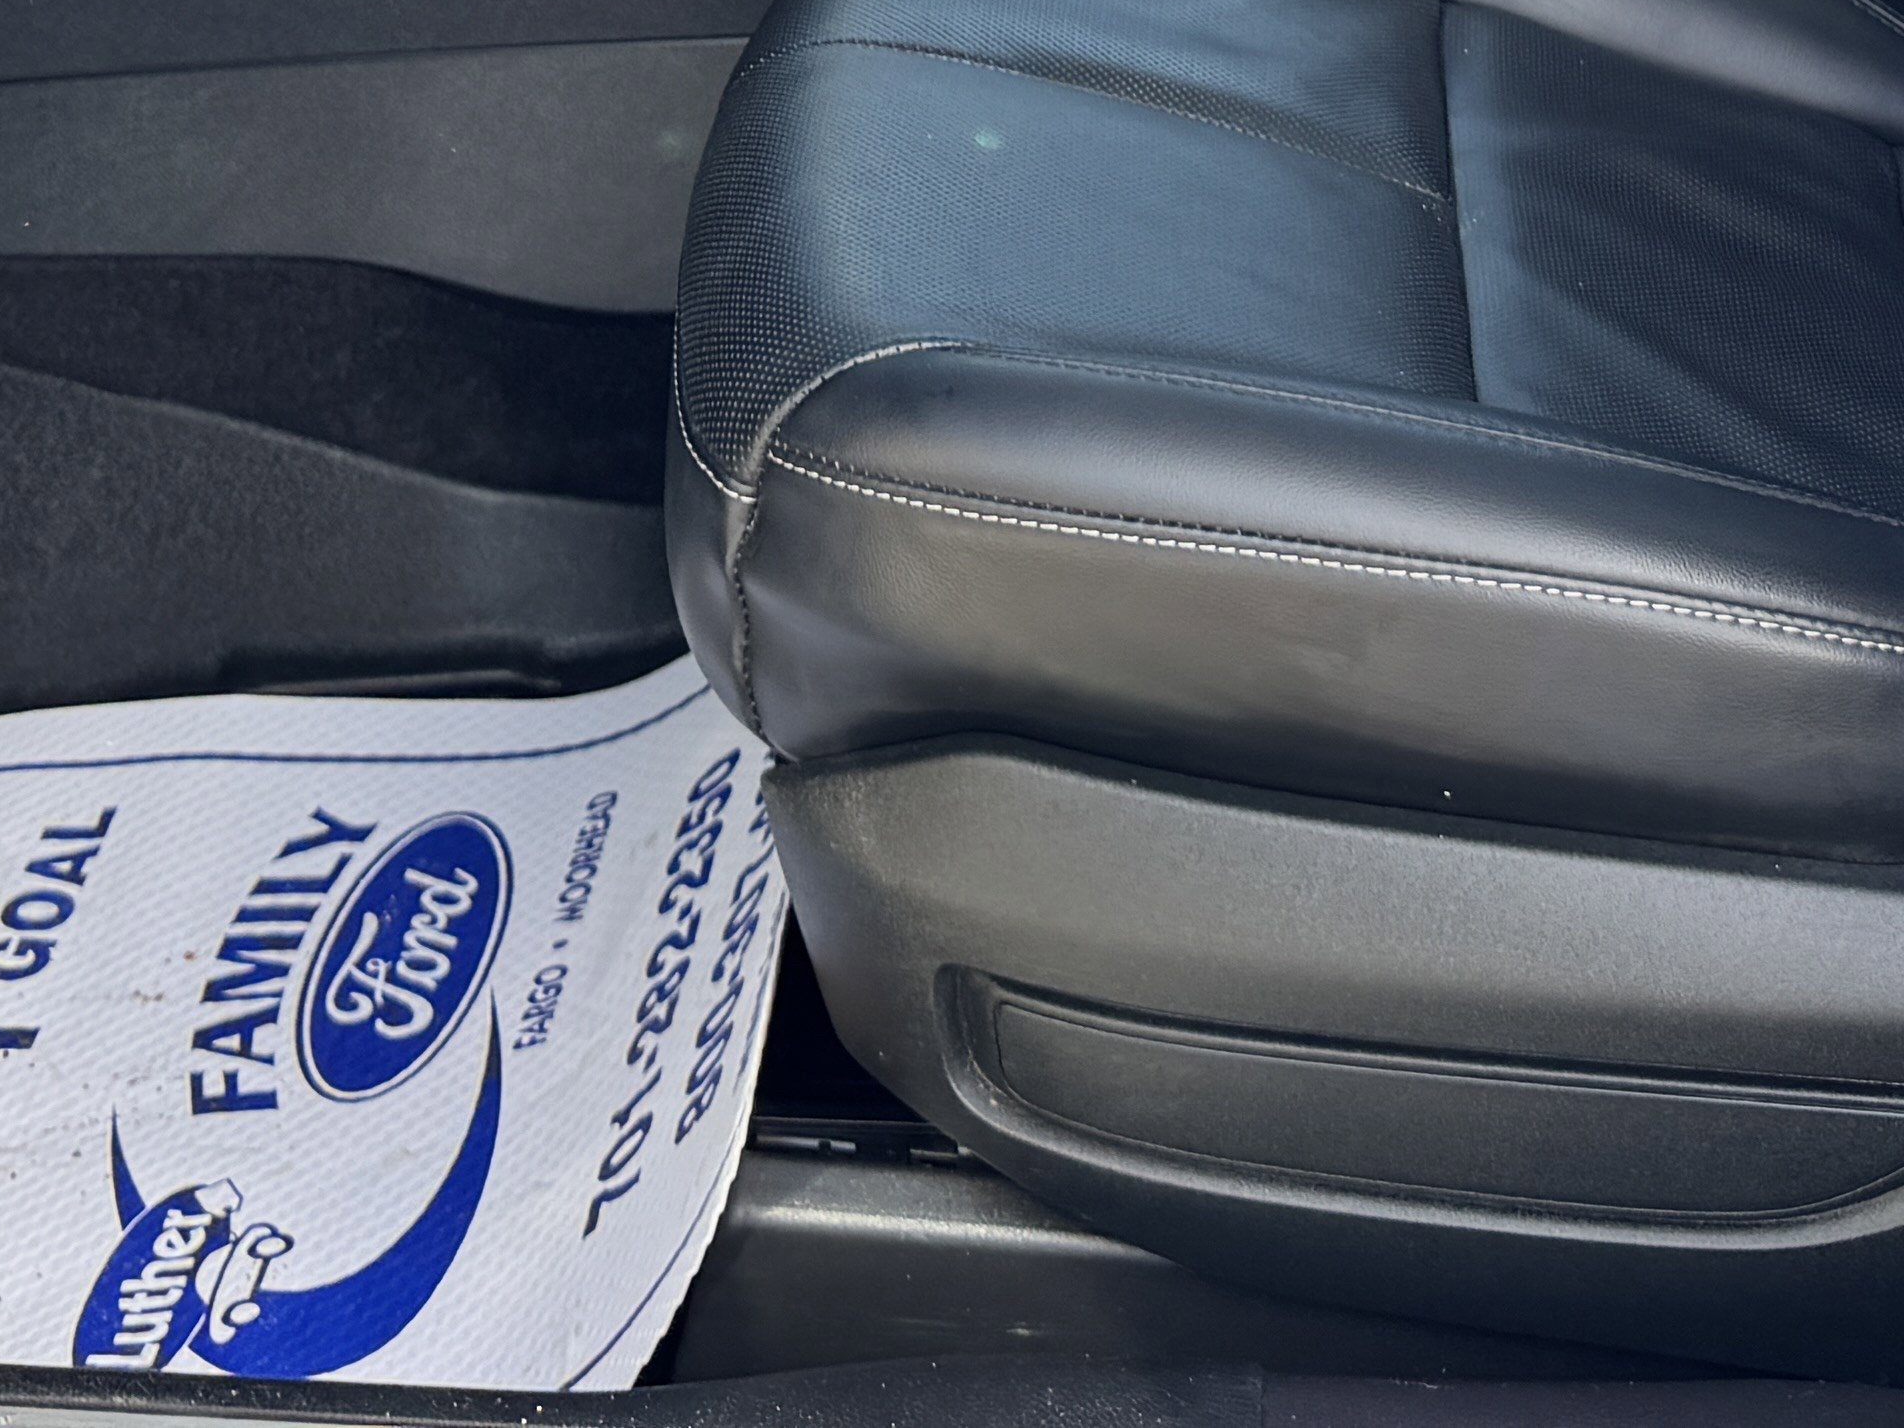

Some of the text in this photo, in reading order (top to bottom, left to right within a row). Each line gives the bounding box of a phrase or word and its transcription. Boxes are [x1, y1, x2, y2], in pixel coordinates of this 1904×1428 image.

[187, 806, 379, 1116] FAMILY
[325, 867, 482, 1042] Ford
[512, 789, 620, 1053] FARGO MOORHEAD
[582, 746, 742, 1240] 701-282-2350
[84, 1208, 215, 1371] Luther
